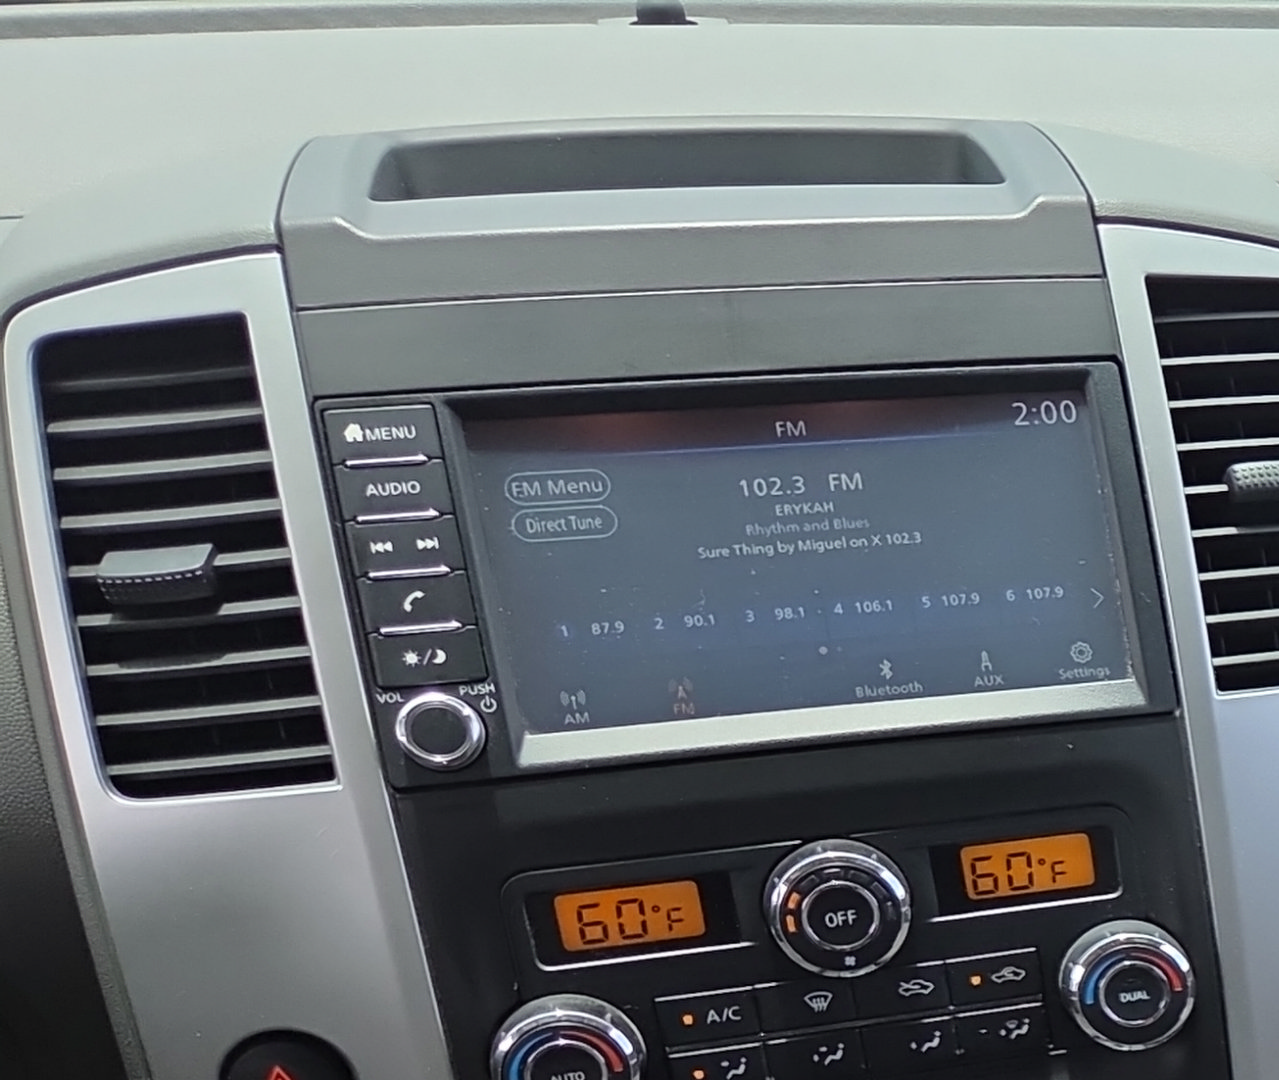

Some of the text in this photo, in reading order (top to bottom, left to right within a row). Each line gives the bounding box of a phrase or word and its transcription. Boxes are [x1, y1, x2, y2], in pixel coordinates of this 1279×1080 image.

[1012, 400, 1077, 426] 2:00
[365, 425, 416, 441] MENU
[775, 420, 806, 437] FM
[366, 480, 420, 497] AUDIO
[511, 477, 603, 497] FM Menu
[739, 472, 863, 497] 102.3 FM
[775, 501, 834, 516] ERYKAH
[525, 515, 603, 532] Direct Tune
[746, 517, 870, 538] Rhythm and Blues
[698, 532, 921, 559] Sure Thing by Miguel on X 102.3
[561, 585, 1064, 637] 1 87.9 2 90.1 3 98.1 4 106.1 5 107.9 6 107.9
[974, 674, 1004, 687] AUX
[376, 691, 405, 705] VOL
[459, 683, 495, 696] PUSH
[855, 680, 923, 699] Bluetooth
[673, 703, 695, 715] FM
[564, 711, 589, 725] AM
[824, 910, 858, 928] OFF
[1119, 990, 1150, 1003] DUAL
[706, 1006, 741, 1024] A/C
